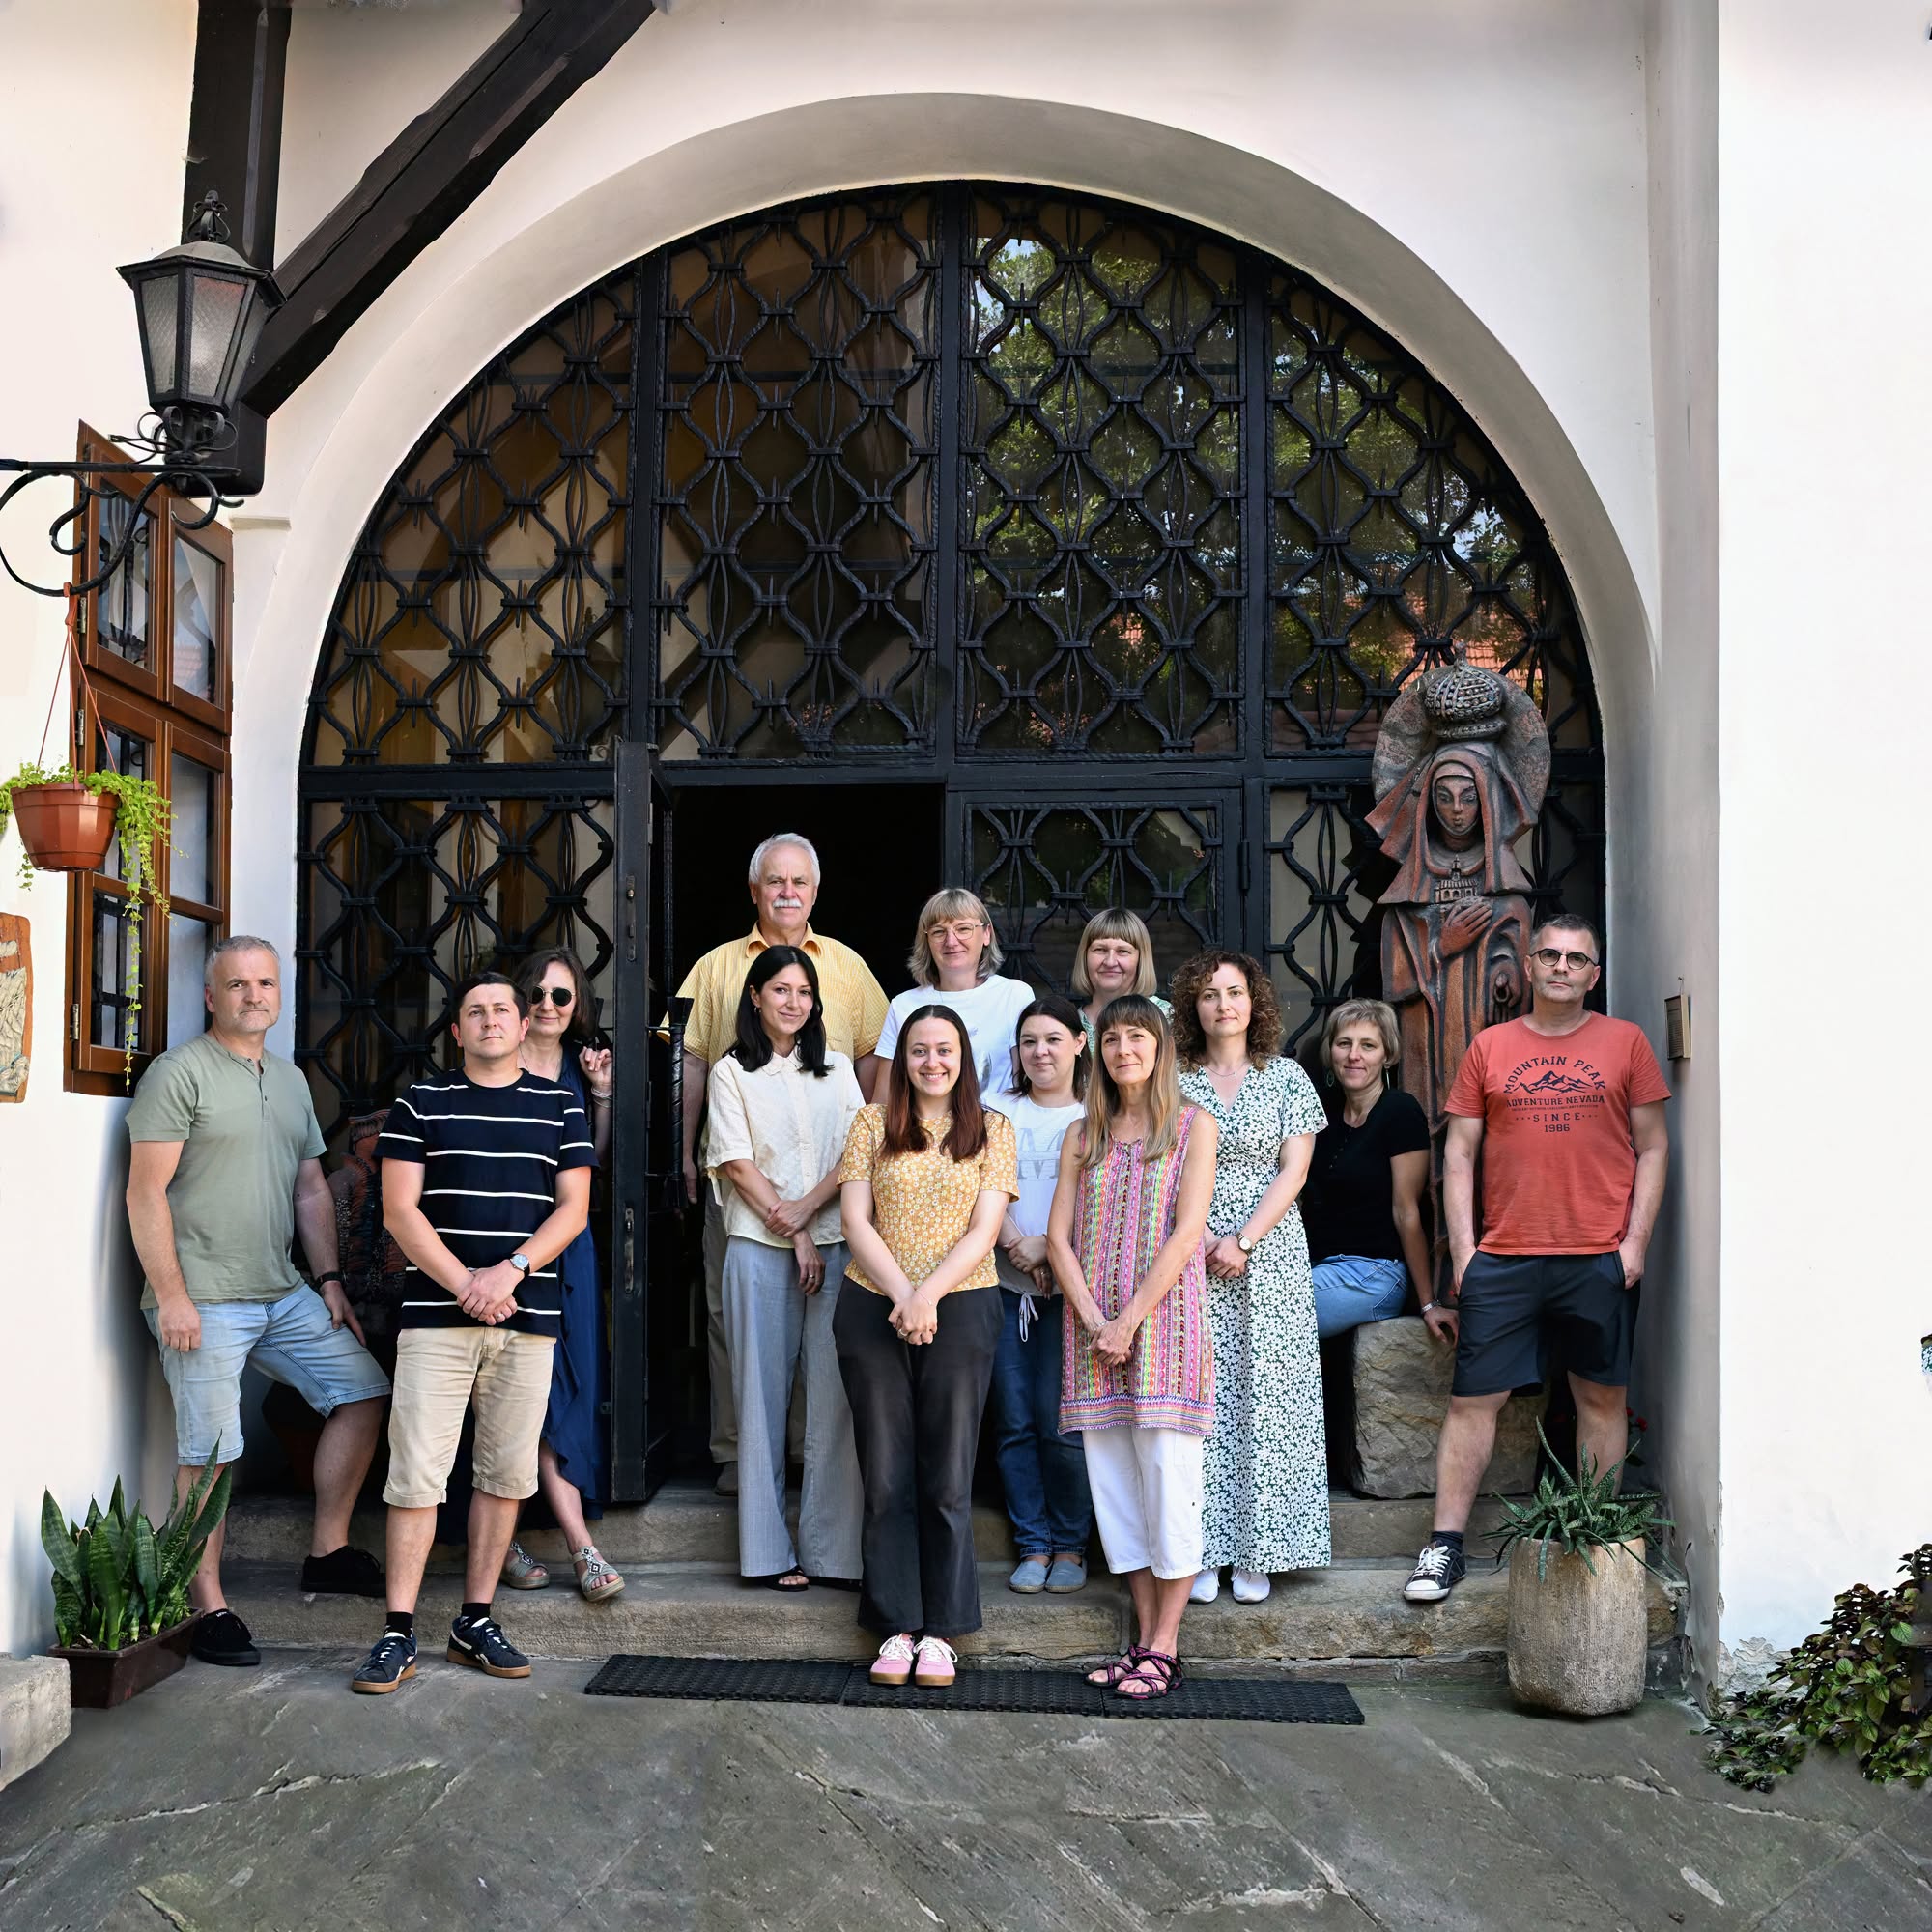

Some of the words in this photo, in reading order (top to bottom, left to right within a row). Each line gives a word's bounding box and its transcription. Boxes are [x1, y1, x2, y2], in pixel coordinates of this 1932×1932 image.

[1503, 1056, 1567, 1094] MOUNTAIN
[1573, 1059, 1606, 1090] PEAK
[1507, 1097, 1563, 1108] ADVENTURE
[1566, 1094, 1605, 1104] NEVADA
[1533, 1112, 1580, 1122] SINCE
[1545, 1123, 1570, 1132] 1986
